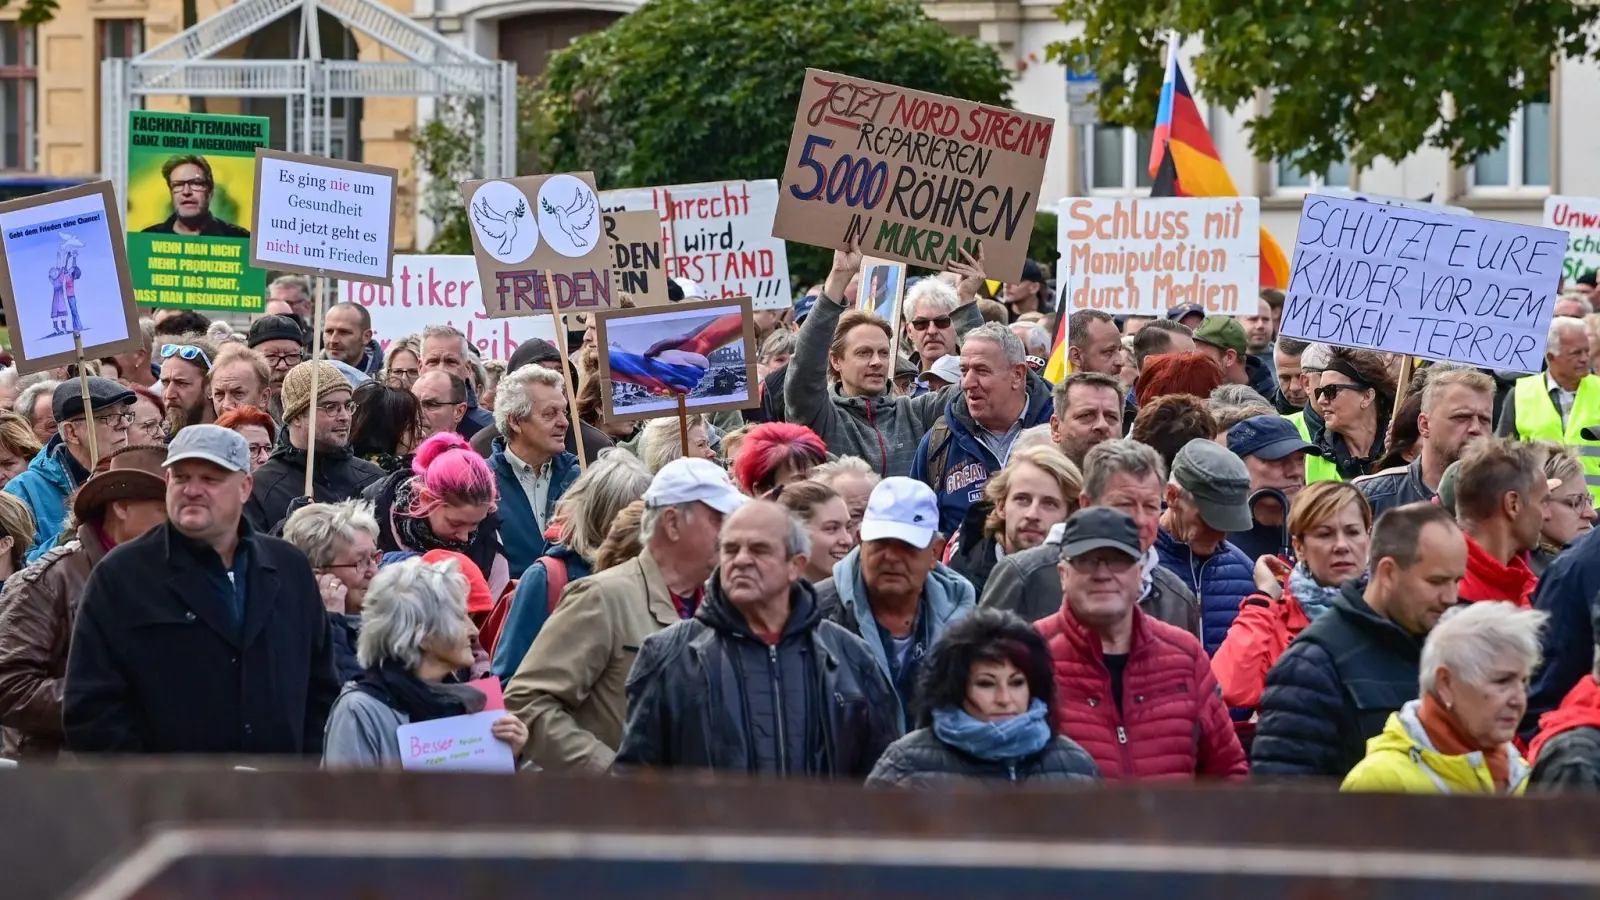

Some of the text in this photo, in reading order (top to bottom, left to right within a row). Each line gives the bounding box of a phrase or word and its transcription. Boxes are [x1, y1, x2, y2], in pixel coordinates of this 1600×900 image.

[133, 116, 263, 138] FACHKRÄFTEMANGEL
[807, 76, 1053, 159] JETZT NORD STREAM
[133, 134, 159, 147] GANZ
[162, 135, 189, 149] OBEN
[857, 123, 992, 178] REPARIEREN
[279, 169, 375, 195] Es ging nie um
[288, 194, 363, 217] Gesundheit
[653, 183, 750, 222] Unrecht
[885, 165, 1031, 241] RÖHREN
[1552, 203, 1600, 229] Unw
[9, 214, 101, 240] Gebt dem Frieden eine Chance!
[271, 217, 377, 242] und jetzt geht es
[1067, 199, 1243, 241] Schluss mit
[151, 240, 242, 257] WENN MAN NICHT
[266, 239, 378, 266] nicht um Frieden
[684, 221, 744, 253] wird,
[843, 213, 982, 265] IN MUKRAN
[1300, 201, 1557, 275] SCHÜTZT EURE
[148, 257, 244, 275] MEHR PRODUZIERT,
[664, 249, 774, 283] ERSTAND
[1070, 242, 1227, 287] Manipulation
[160, 290, 183, 304] MAN
[185, 292, 239, 307] INSOLVENT
[241, 295, 262, 308] IST!
[182, 275, 204, 288] DAS
[206, 277, 240, 291] NICHT,
[495, 268, 611, 311] FRIEDEN
[1073, 273, 1239, 312] durch Medien
[1289, 250, 1547, 328] KINDER VOR DEM
[946, 462, 987, 495] GREAT
[410, 736, 455, 758] Besser
